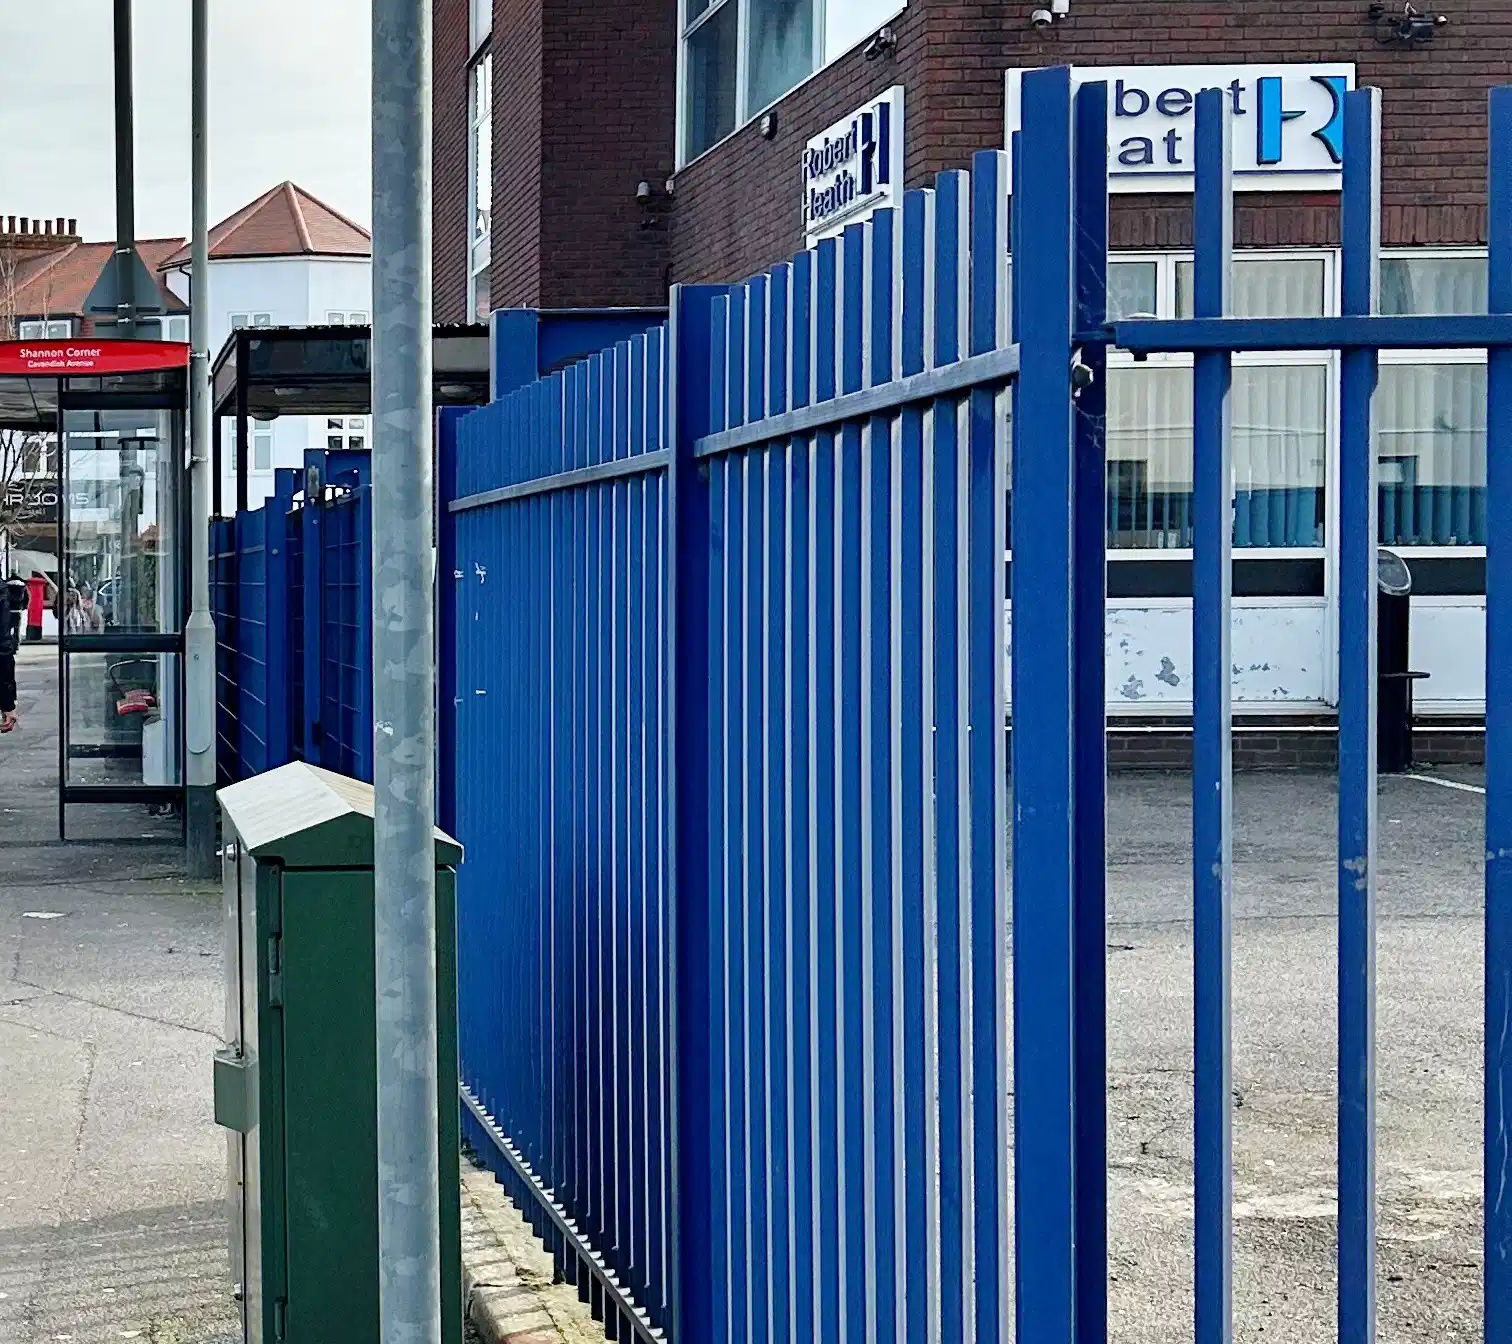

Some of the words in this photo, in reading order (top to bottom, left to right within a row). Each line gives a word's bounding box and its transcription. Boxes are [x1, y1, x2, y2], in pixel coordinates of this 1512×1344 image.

[1115, 77, 1247, 116] bet
[801, 120, 858, 180] Robert
[801, 169, 855, 227] Heath
[19, 348, 64, 358] Shannon
[66, 347, 102, 357] Corner
[28, 360, 65, 368] Cavendish
[67, 359, 94, 367] Avenue
